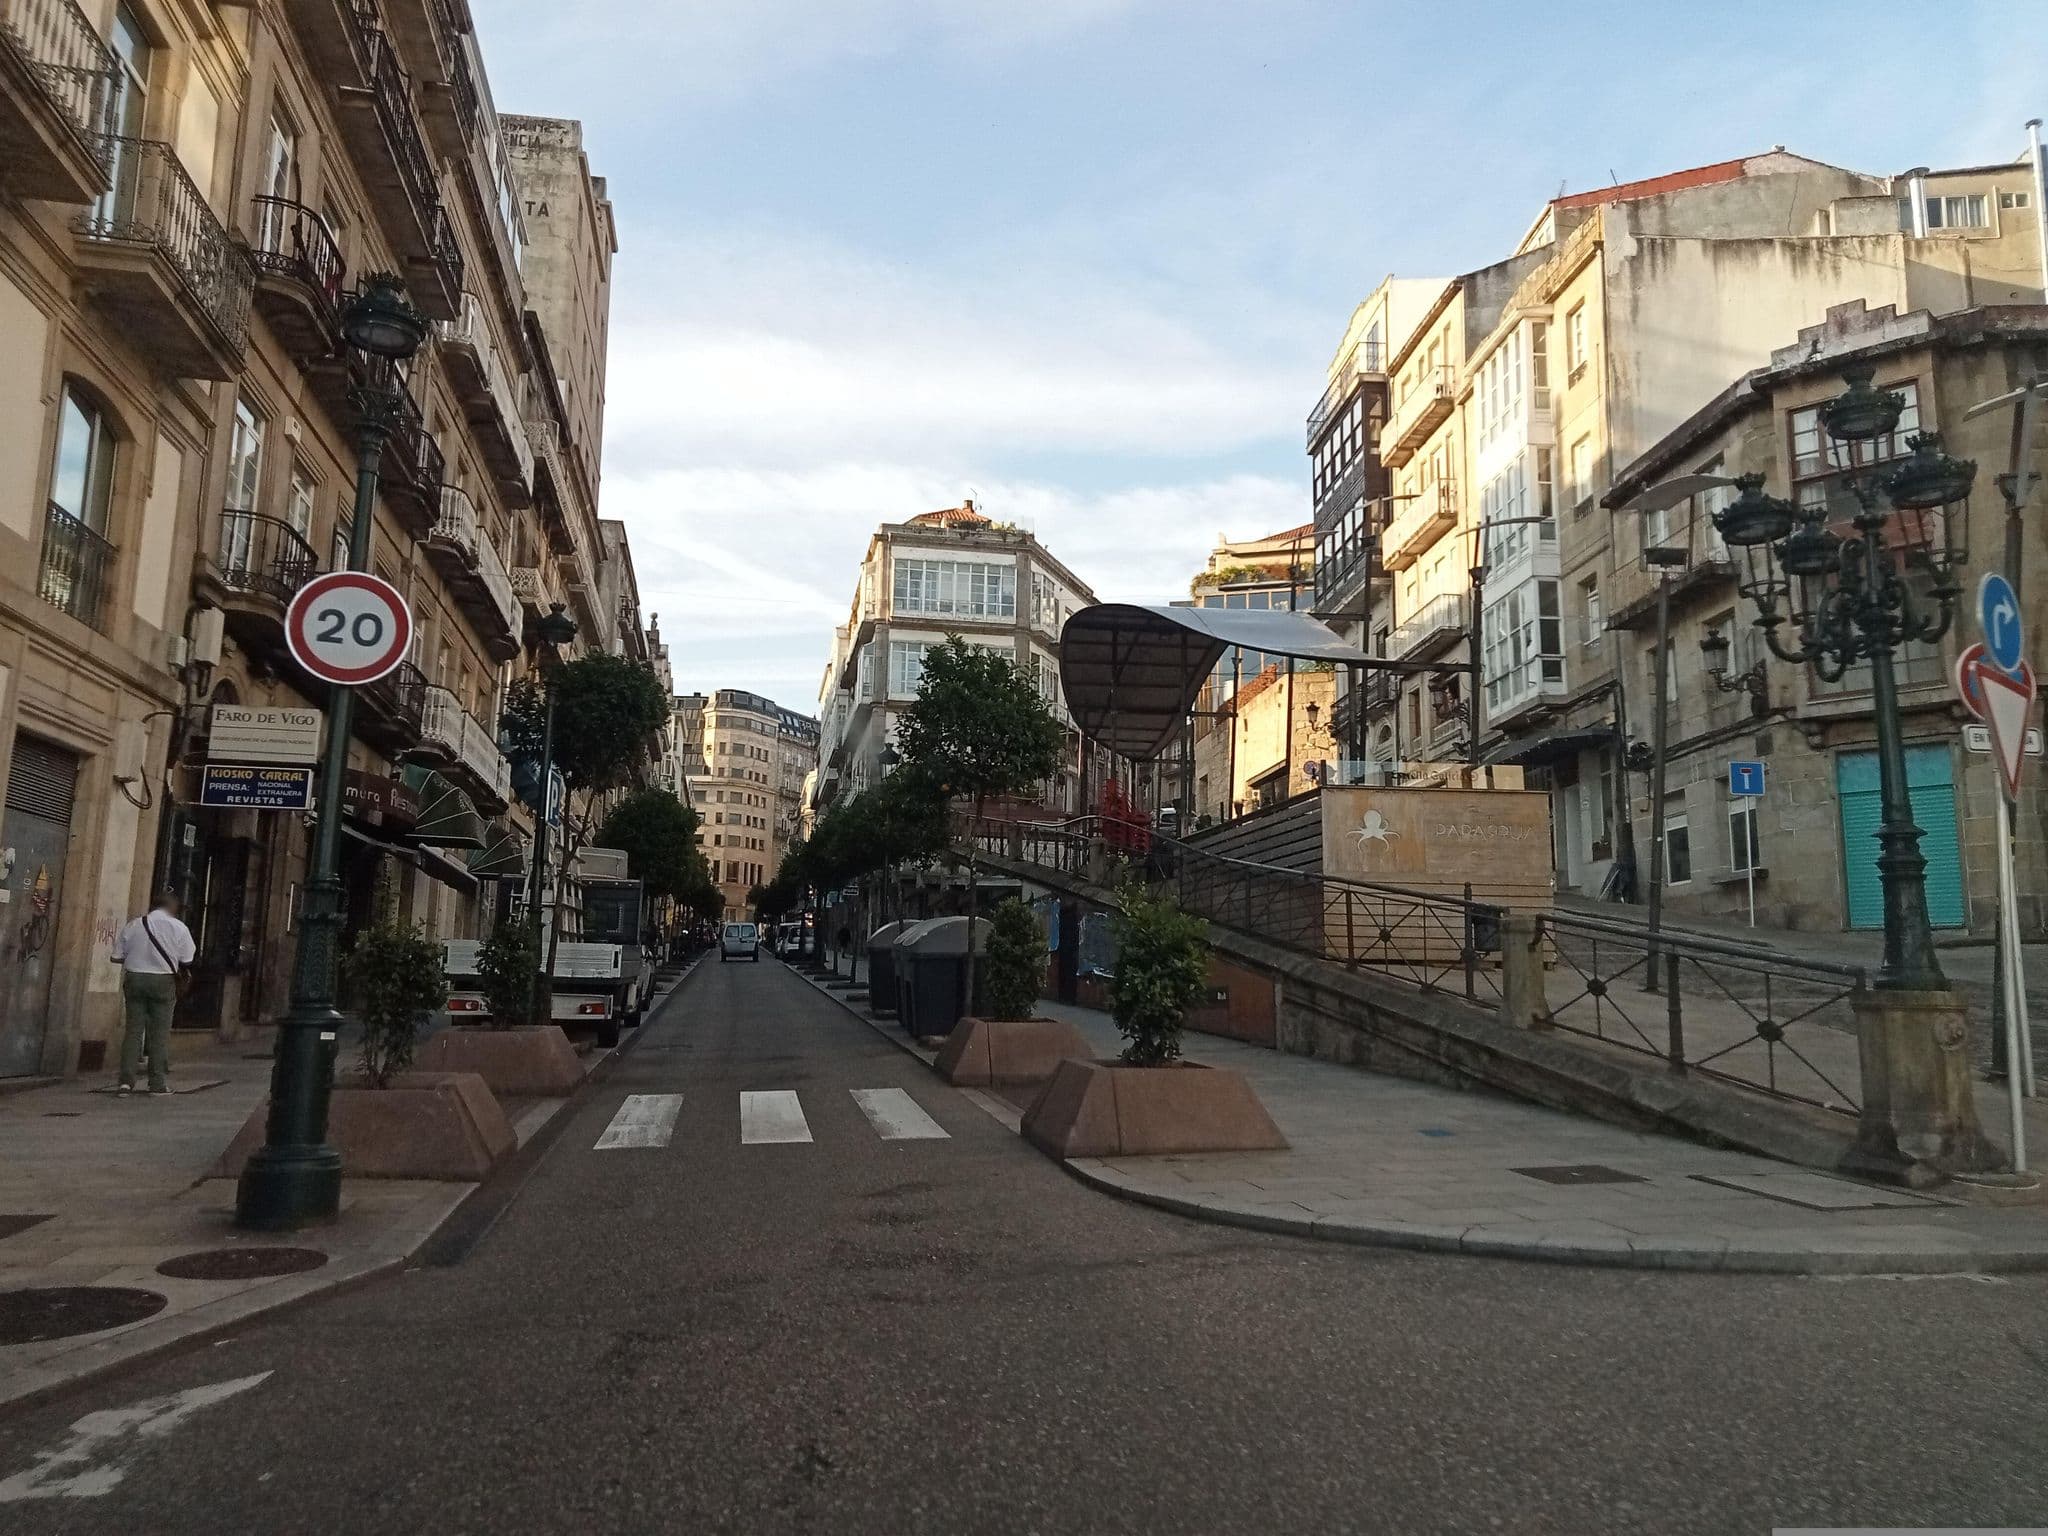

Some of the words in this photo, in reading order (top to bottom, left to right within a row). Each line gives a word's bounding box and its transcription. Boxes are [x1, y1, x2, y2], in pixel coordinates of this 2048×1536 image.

[315, 608, 383, 647] 20
[215, 708, 252, 723] FARO
[257, 713, 276, 724] DE
[281, 712, 315, 726] VIGO
[210, 769, 254, 780] KIOSKO
[259, 770, 305, 782] CARRAL
[209, 782, 250, 792] PRENSA:
[257, 789, 302, 797] EXTRANJERA
[226, 795, 284, 805] REVISTAS
[550, 780, 558, 819] P
